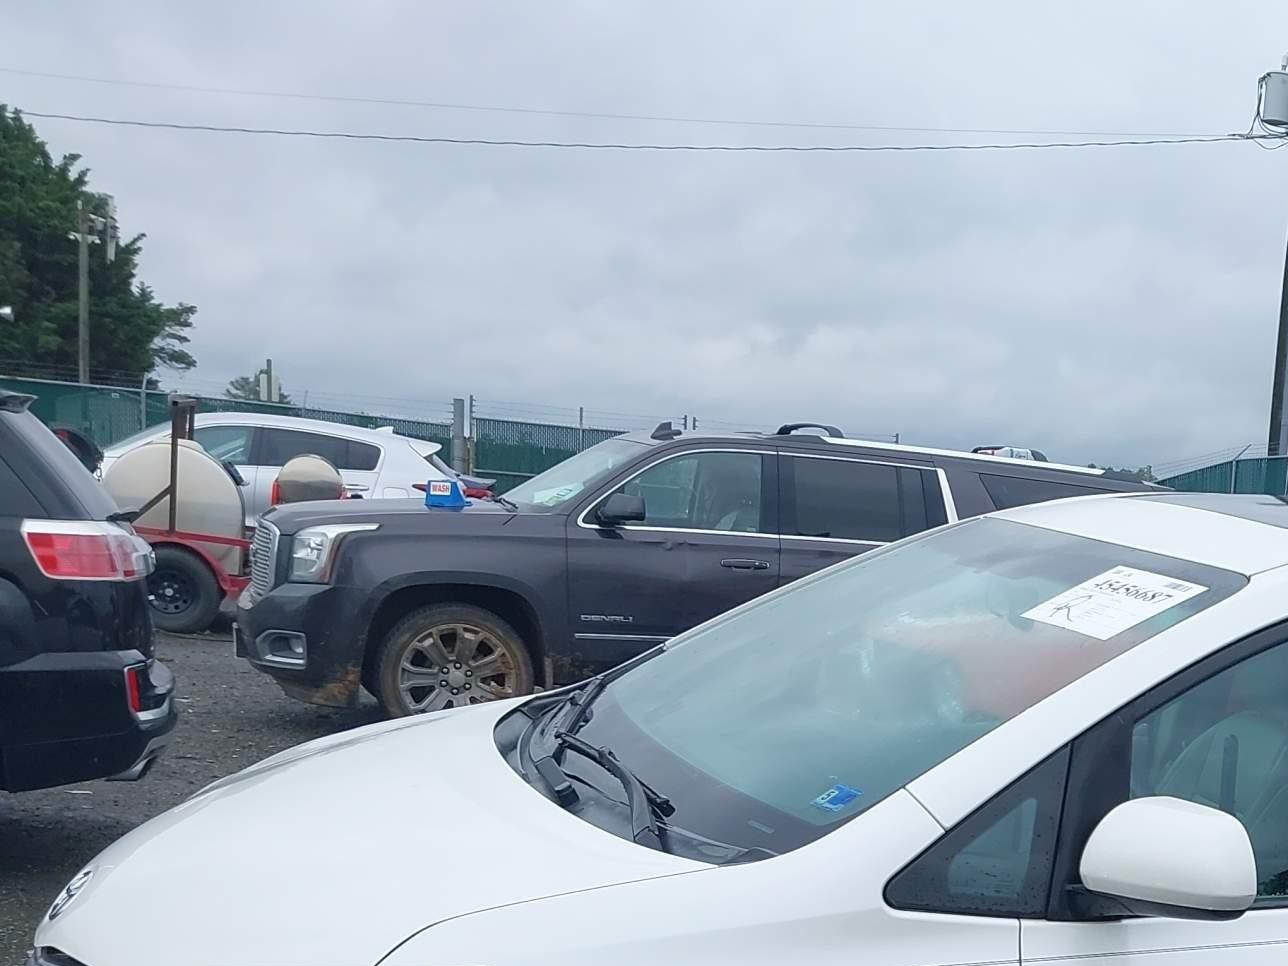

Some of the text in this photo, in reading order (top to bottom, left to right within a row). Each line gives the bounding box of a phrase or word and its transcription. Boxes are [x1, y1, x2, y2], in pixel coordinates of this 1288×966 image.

[431, 484, 450, 493] WASH
[1094, 579, 1175, 604] 45456687
[580, 614, 633, 623] DENALI
